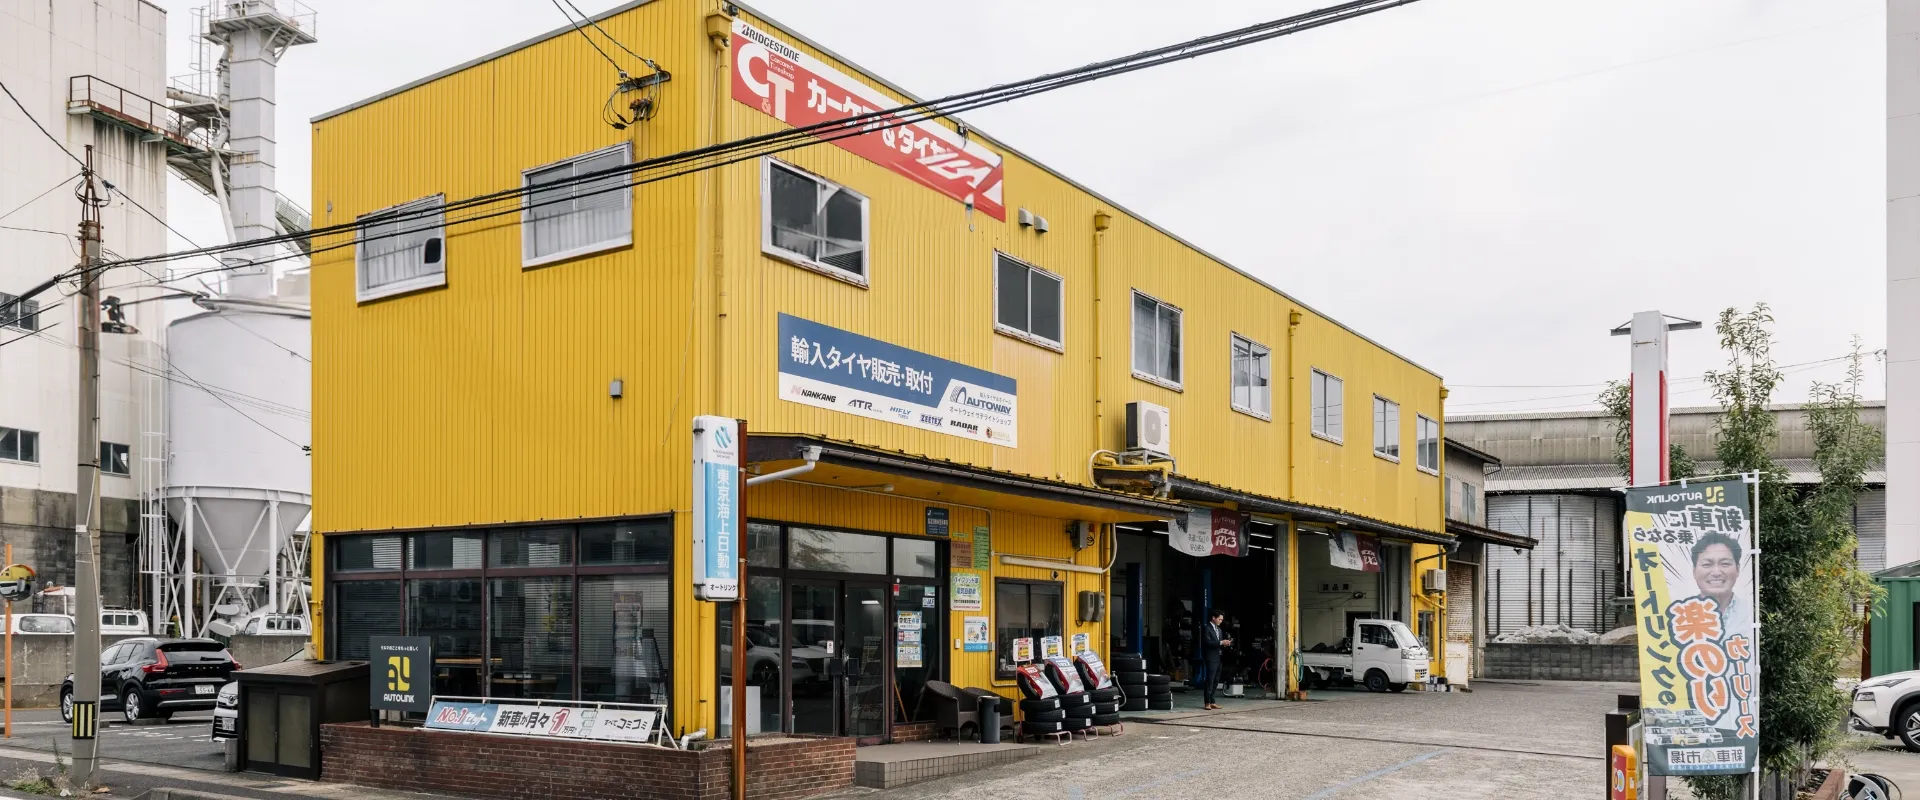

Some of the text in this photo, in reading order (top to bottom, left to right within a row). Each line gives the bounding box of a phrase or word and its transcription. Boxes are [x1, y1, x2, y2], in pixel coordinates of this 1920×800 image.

[741, 23, 800, 63] BRIDGESTONE
[791, 334, 934, 395] 輸入タイヤ販売・取付
[801, 389, 837, 403] NANKANG
[847, 399, 873, 411] ATR
[889, 406, 912, 415] HIFLY
[966, 396, 1012, 415] AUTOWAY
[920, 413, 944, 427] ZEETEX
[950, 420, 979, 431] RADAR
[717, 469, 730, 569] 東京海上日動
[383, 693, 415, 703] AUTOLINK
[604, 718, 648, 730] すべてコミコミ
